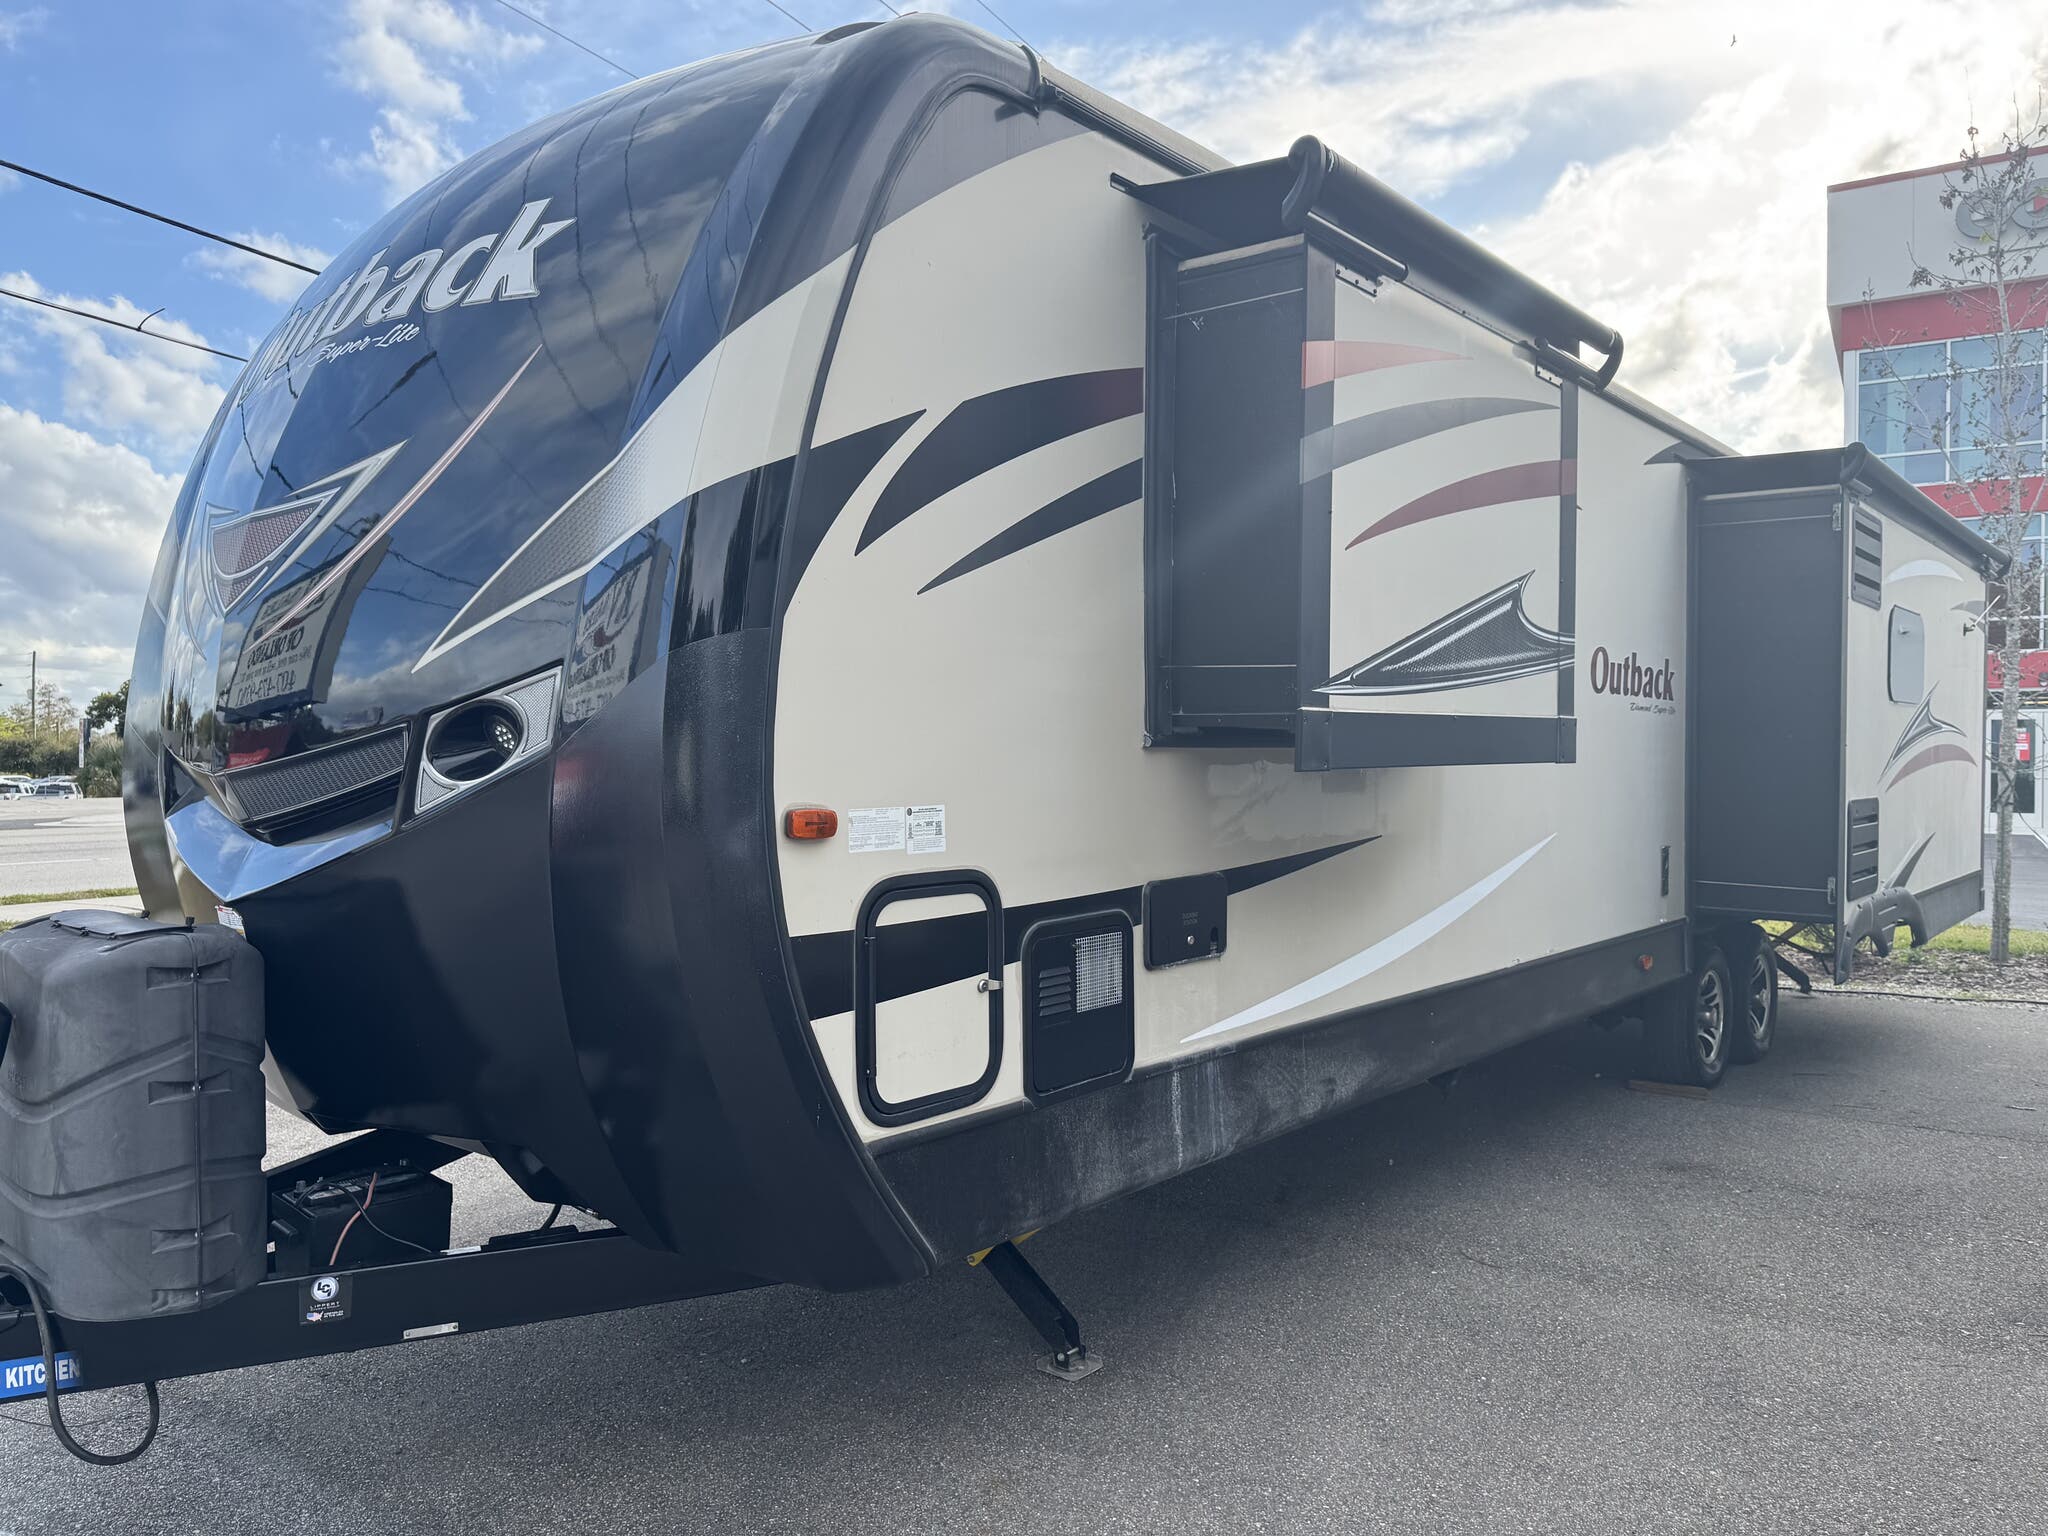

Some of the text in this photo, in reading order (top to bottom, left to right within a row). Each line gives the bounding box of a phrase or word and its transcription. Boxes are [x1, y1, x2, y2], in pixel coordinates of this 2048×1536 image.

[236, 198, 577, 408] Outback
[308, 323, 421, 367] Super-Lite
[1590, 646, 1675, 701] Outback
